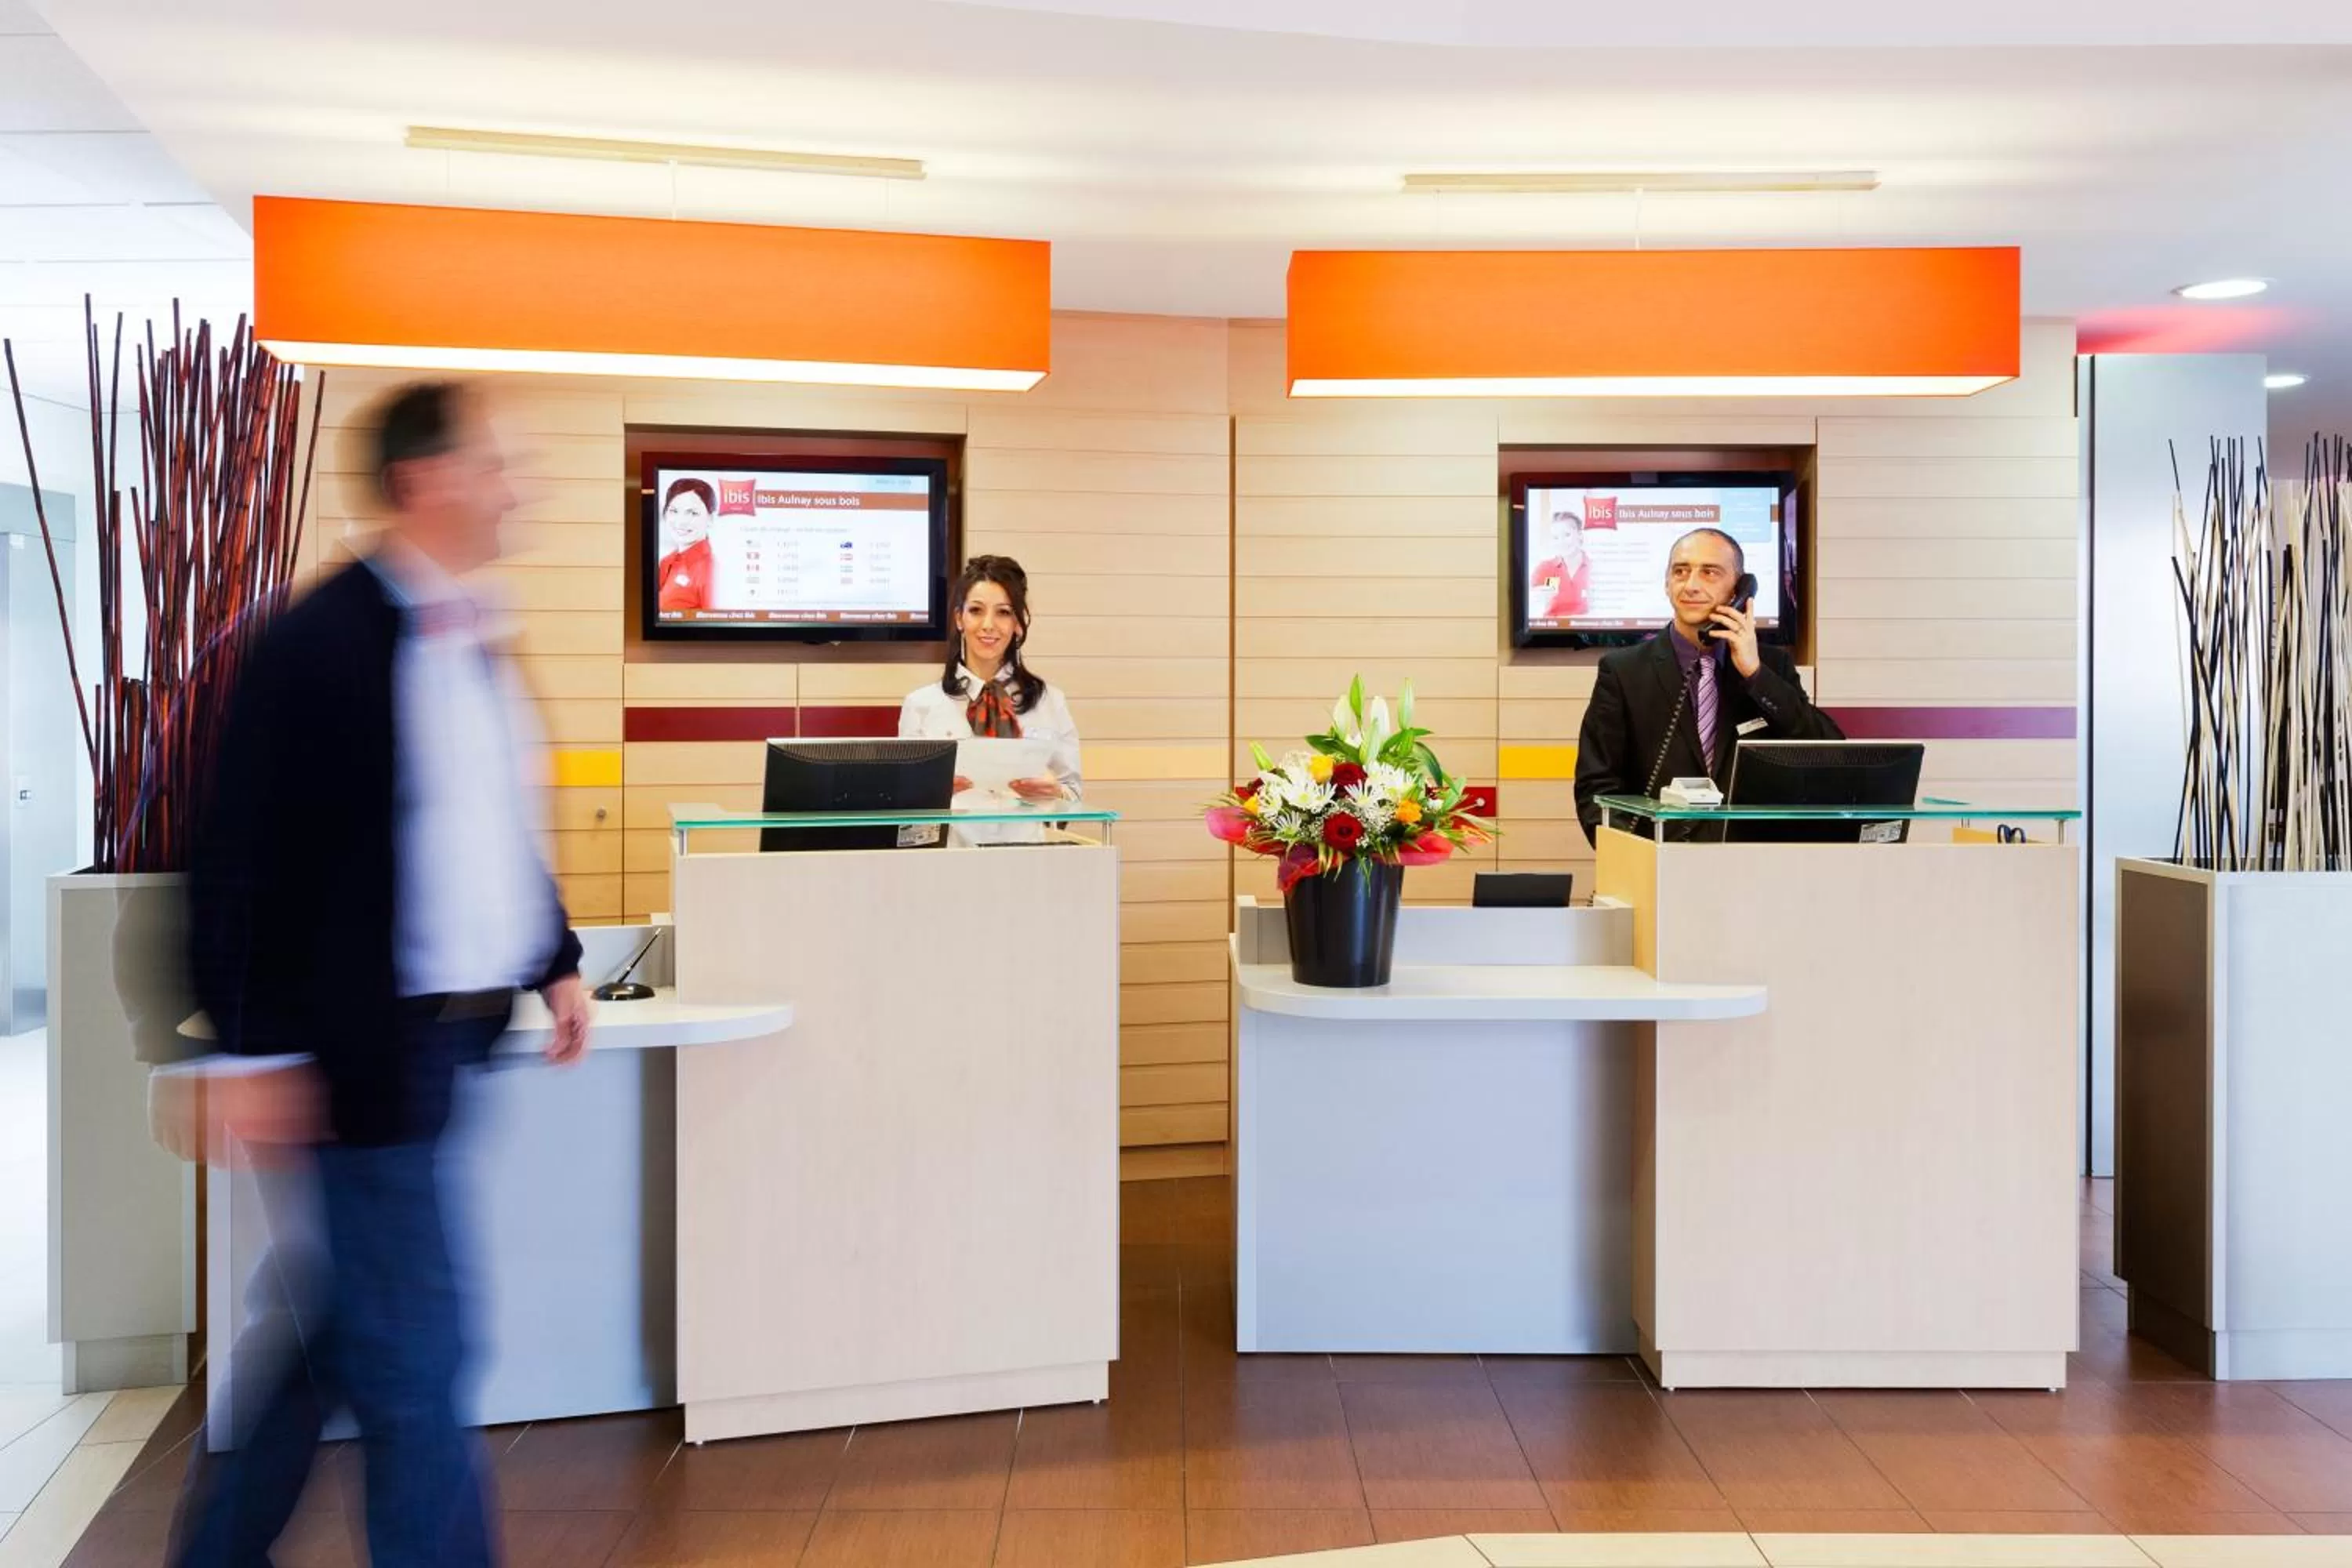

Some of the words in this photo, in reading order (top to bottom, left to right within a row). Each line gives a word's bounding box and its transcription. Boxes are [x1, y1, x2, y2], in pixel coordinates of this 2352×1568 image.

[724, 488, 750, 504] ibis
[777, 494, 811, 508] Aulnay
[814, 497, 837, 506] sous
[838, 495, 860, 506] bois
[1588, 506, 1613, 519] ibis
